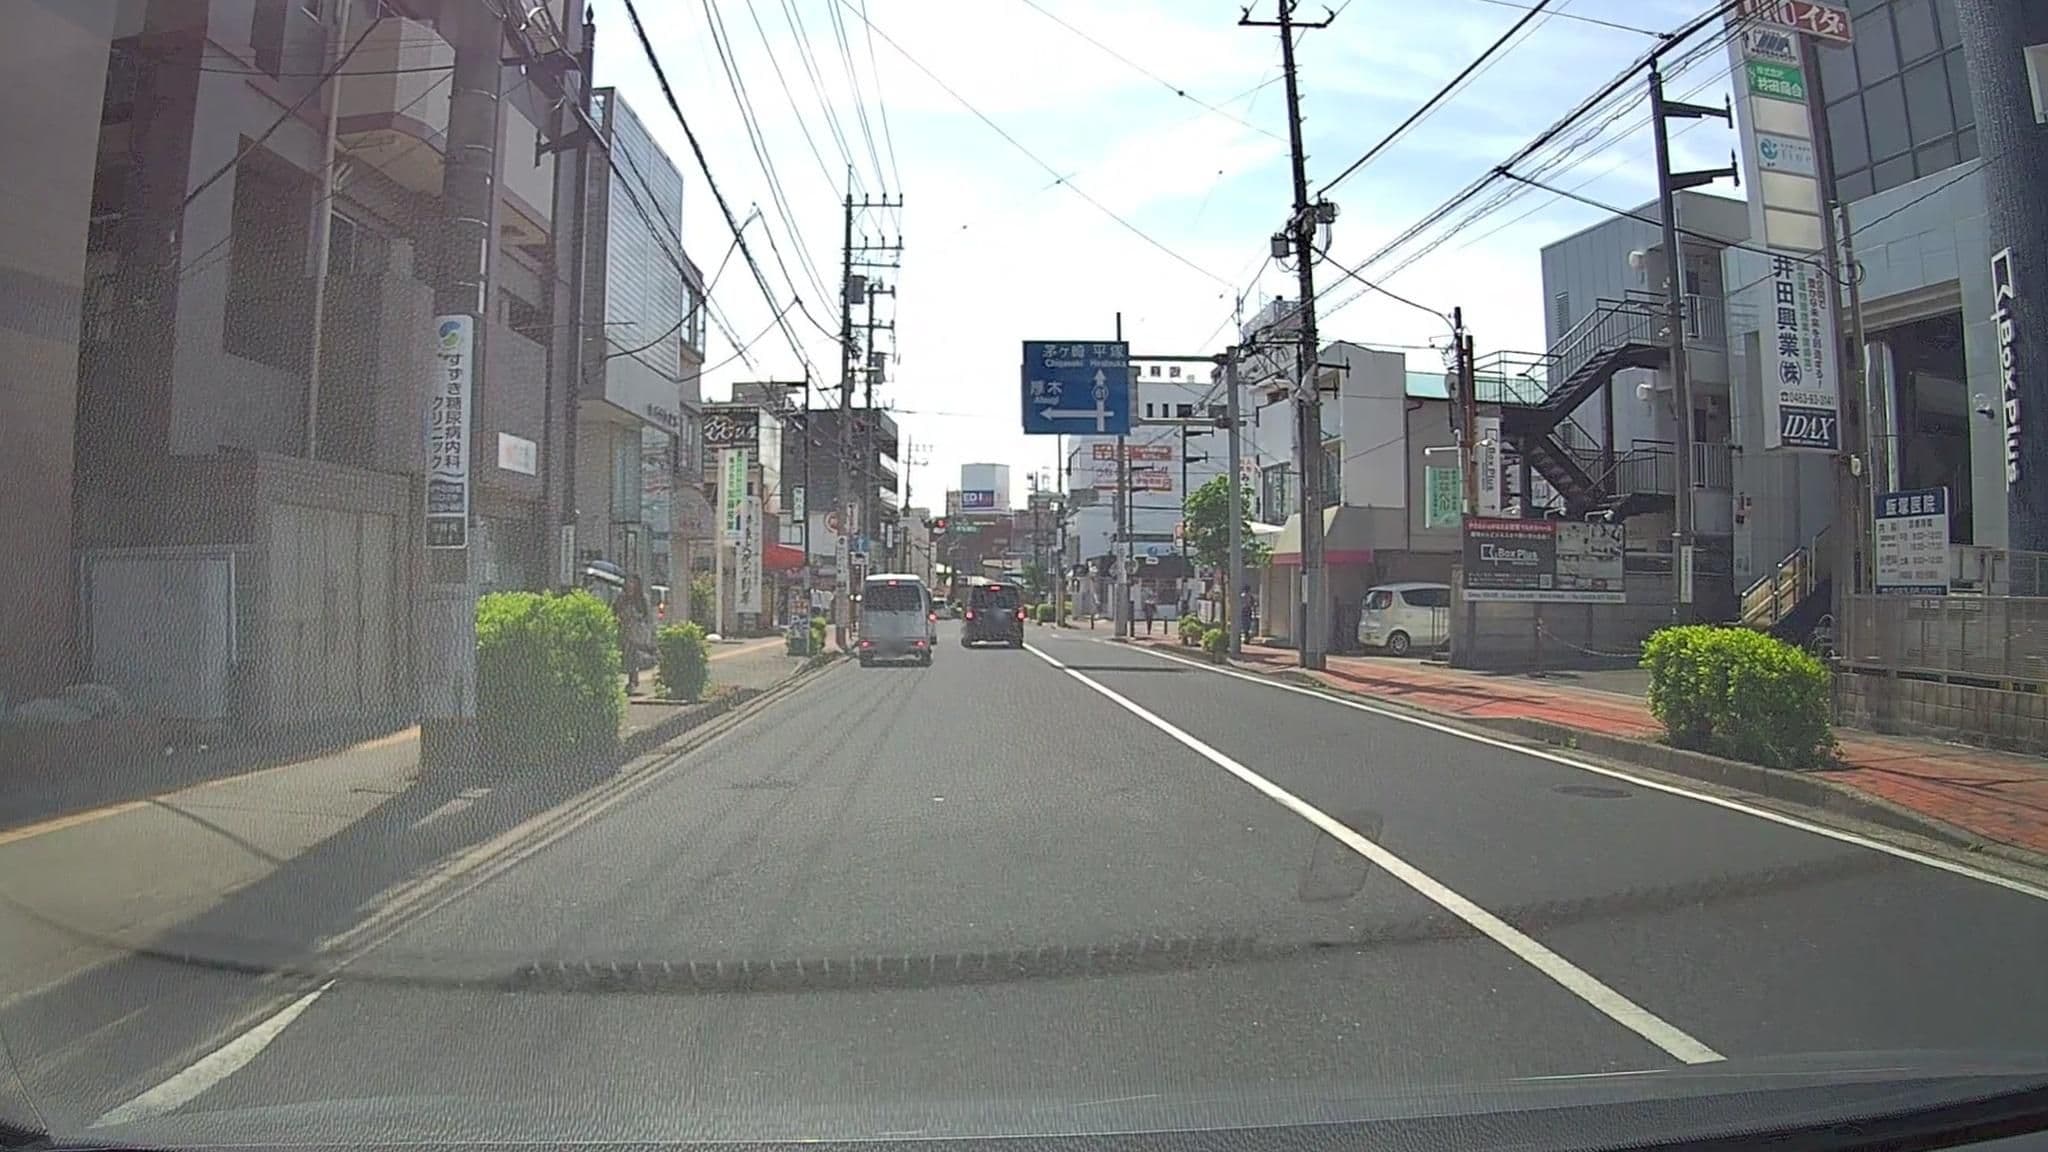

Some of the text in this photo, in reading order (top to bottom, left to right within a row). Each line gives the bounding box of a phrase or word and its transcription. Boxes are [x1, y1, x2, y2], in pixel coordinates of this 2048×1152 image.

[1030, 381, 1063, 396] 厚木
[431, 397, 444, 469] クリニック
[1782, 415, 1835, 440] IDAX
